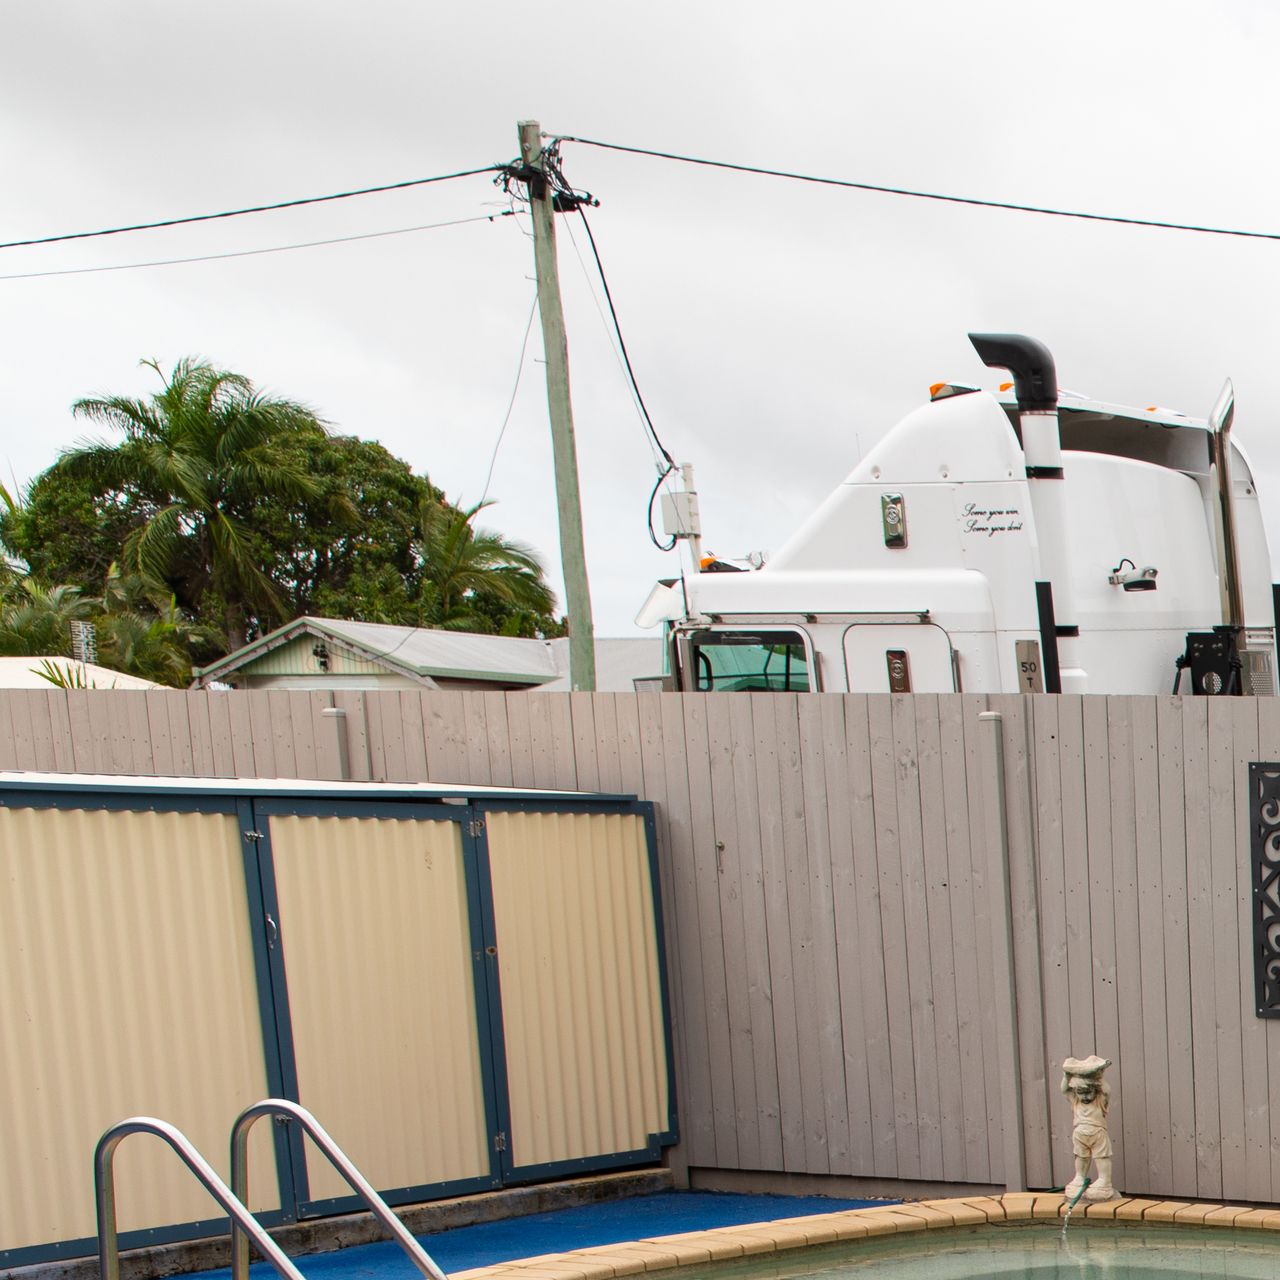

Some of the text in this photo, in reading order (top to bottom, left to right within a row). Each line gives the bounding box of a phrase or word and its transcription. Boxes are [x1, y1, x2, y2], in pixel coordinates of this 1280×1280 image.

[987, 510, 1004, 521] you
[988, 527, 1005, 537] you
[1021, 661, 1037, 673] 50
[1026, 677, 1033, 688] T
